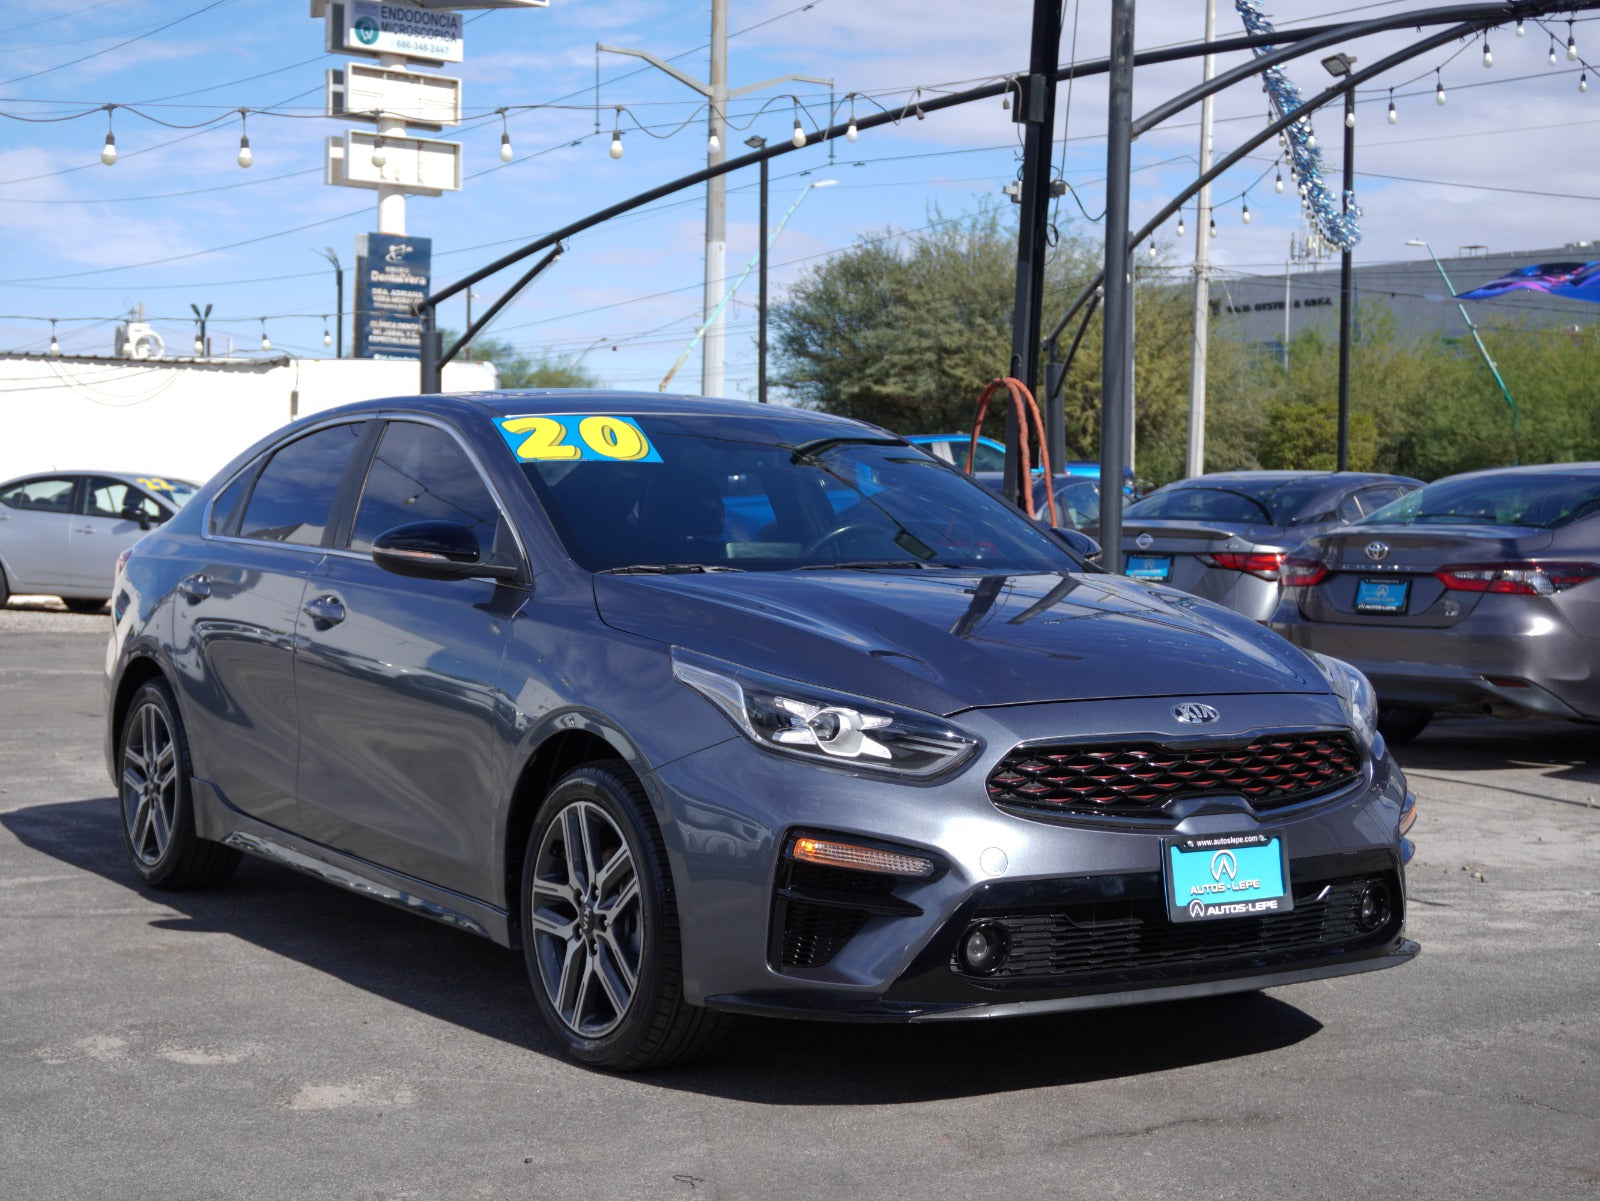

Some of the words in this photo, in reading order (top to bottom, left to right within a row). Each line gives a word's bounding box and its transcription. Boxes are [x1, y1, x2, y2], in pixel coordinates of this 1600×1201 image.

[381, 6, 457, 29] ENDODONCIA
[396, 40, 450, 53] 686-348-2447
[501, 416, 650, 460] 20
[1177, 705, 1216, 720] KIA
[1196, 835, 1258, 847] www.autoslepe.com
